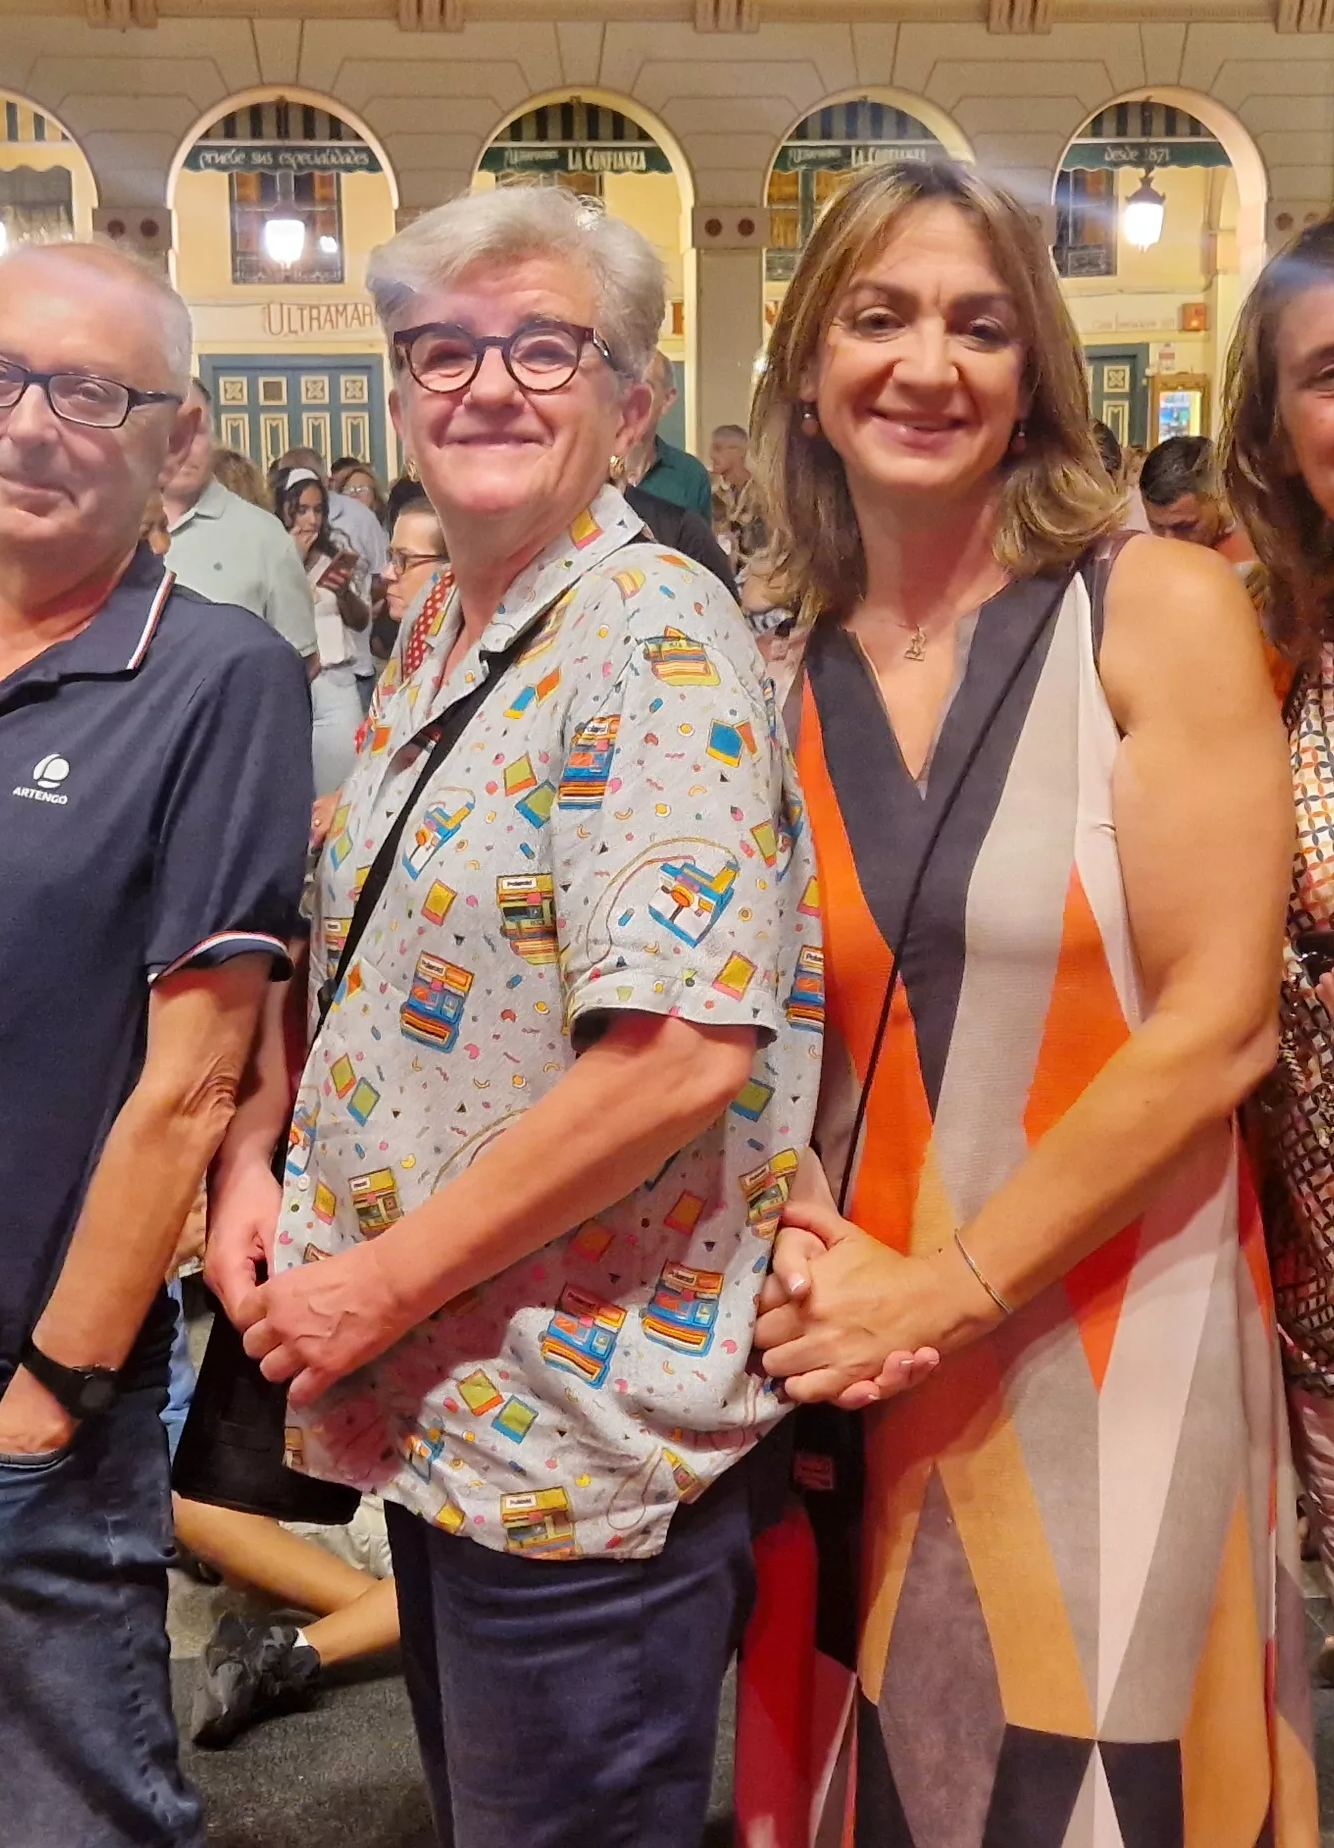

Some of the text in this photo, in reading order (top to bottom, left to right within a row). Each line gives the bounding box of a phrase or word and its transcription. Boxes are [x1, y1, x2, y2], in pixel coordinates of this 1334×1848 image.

[568, 148, 583, 171] LA
[266, 301, 377, 336] ULTRAMAR
[12, 786, 68, 805] ARTENGO
